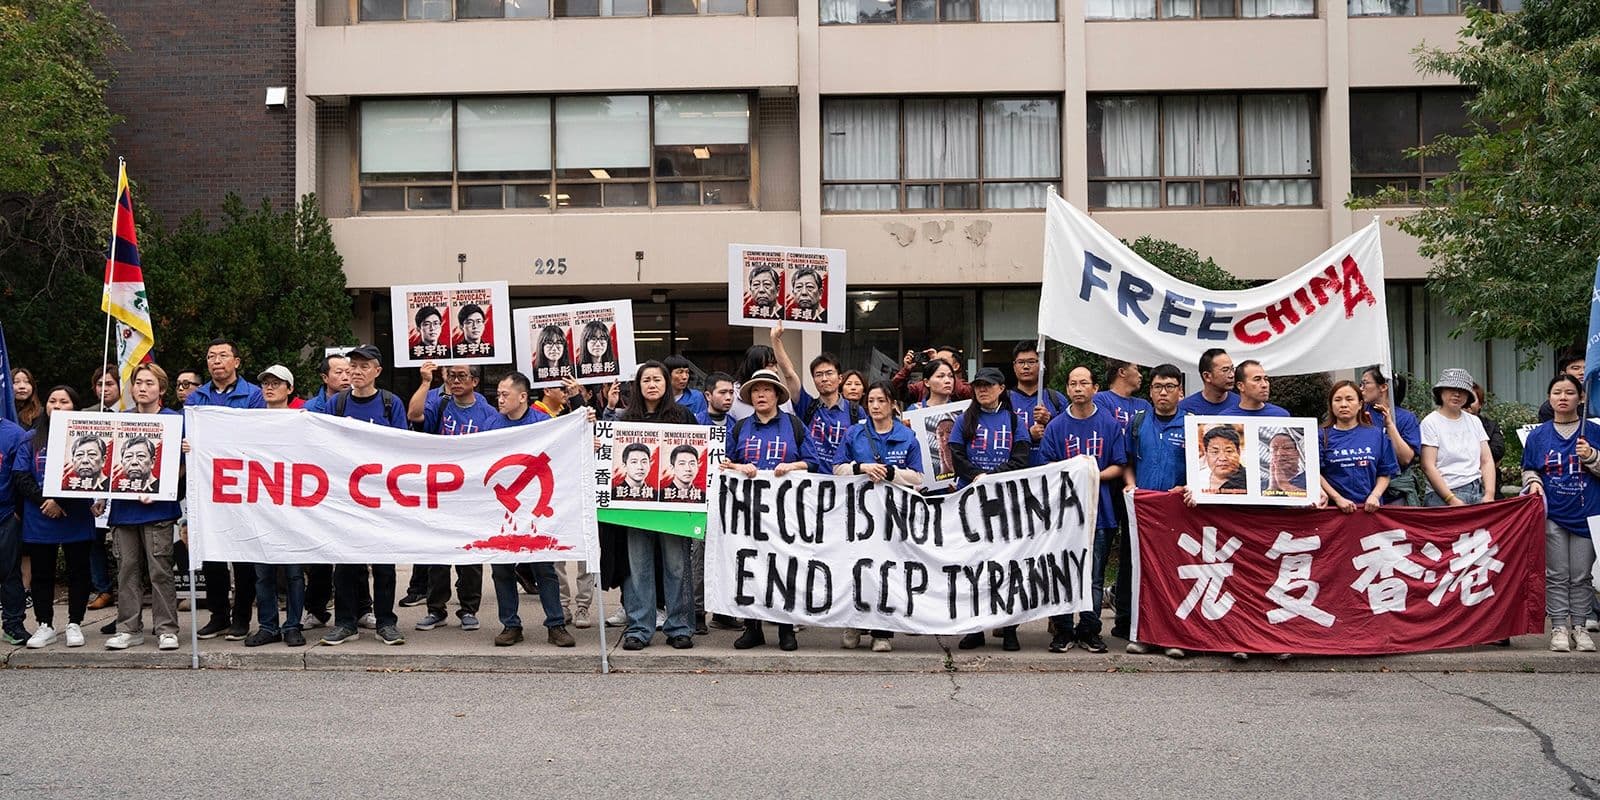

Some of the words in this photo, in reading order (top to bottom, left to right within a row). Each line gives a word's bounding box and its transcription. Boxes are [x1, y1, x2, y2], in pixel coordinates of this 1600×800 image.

[535, 257, 567, 275] 225
[456, 293, 487, 301] ADVOCACY
[1079, 250, 1237, 341] FREE
[1233, 254, 1377, 345] CHINA
[745, 436, 787, 463] 自由
[970, 423, 1013, 451] 自由
[1065, 431, 1104, 461] 自由
[212, 457, 329, 507] END
[349, 463, 465, 509] CCP
[595, 421, 614, 508] 光復香港
[775, 478, 836, 544] CCP
[846, 481, 875, 543] IS
[883, 485, 945, 547] NOT
[958, 471, 1084, 543] CHINA
[735, 548, 832, 614] END
[853, 558, 928, 616] CCP
[942, 548, 1087, 619] TYRANNY
[1175, 526, 1505, 628] 光复香港
